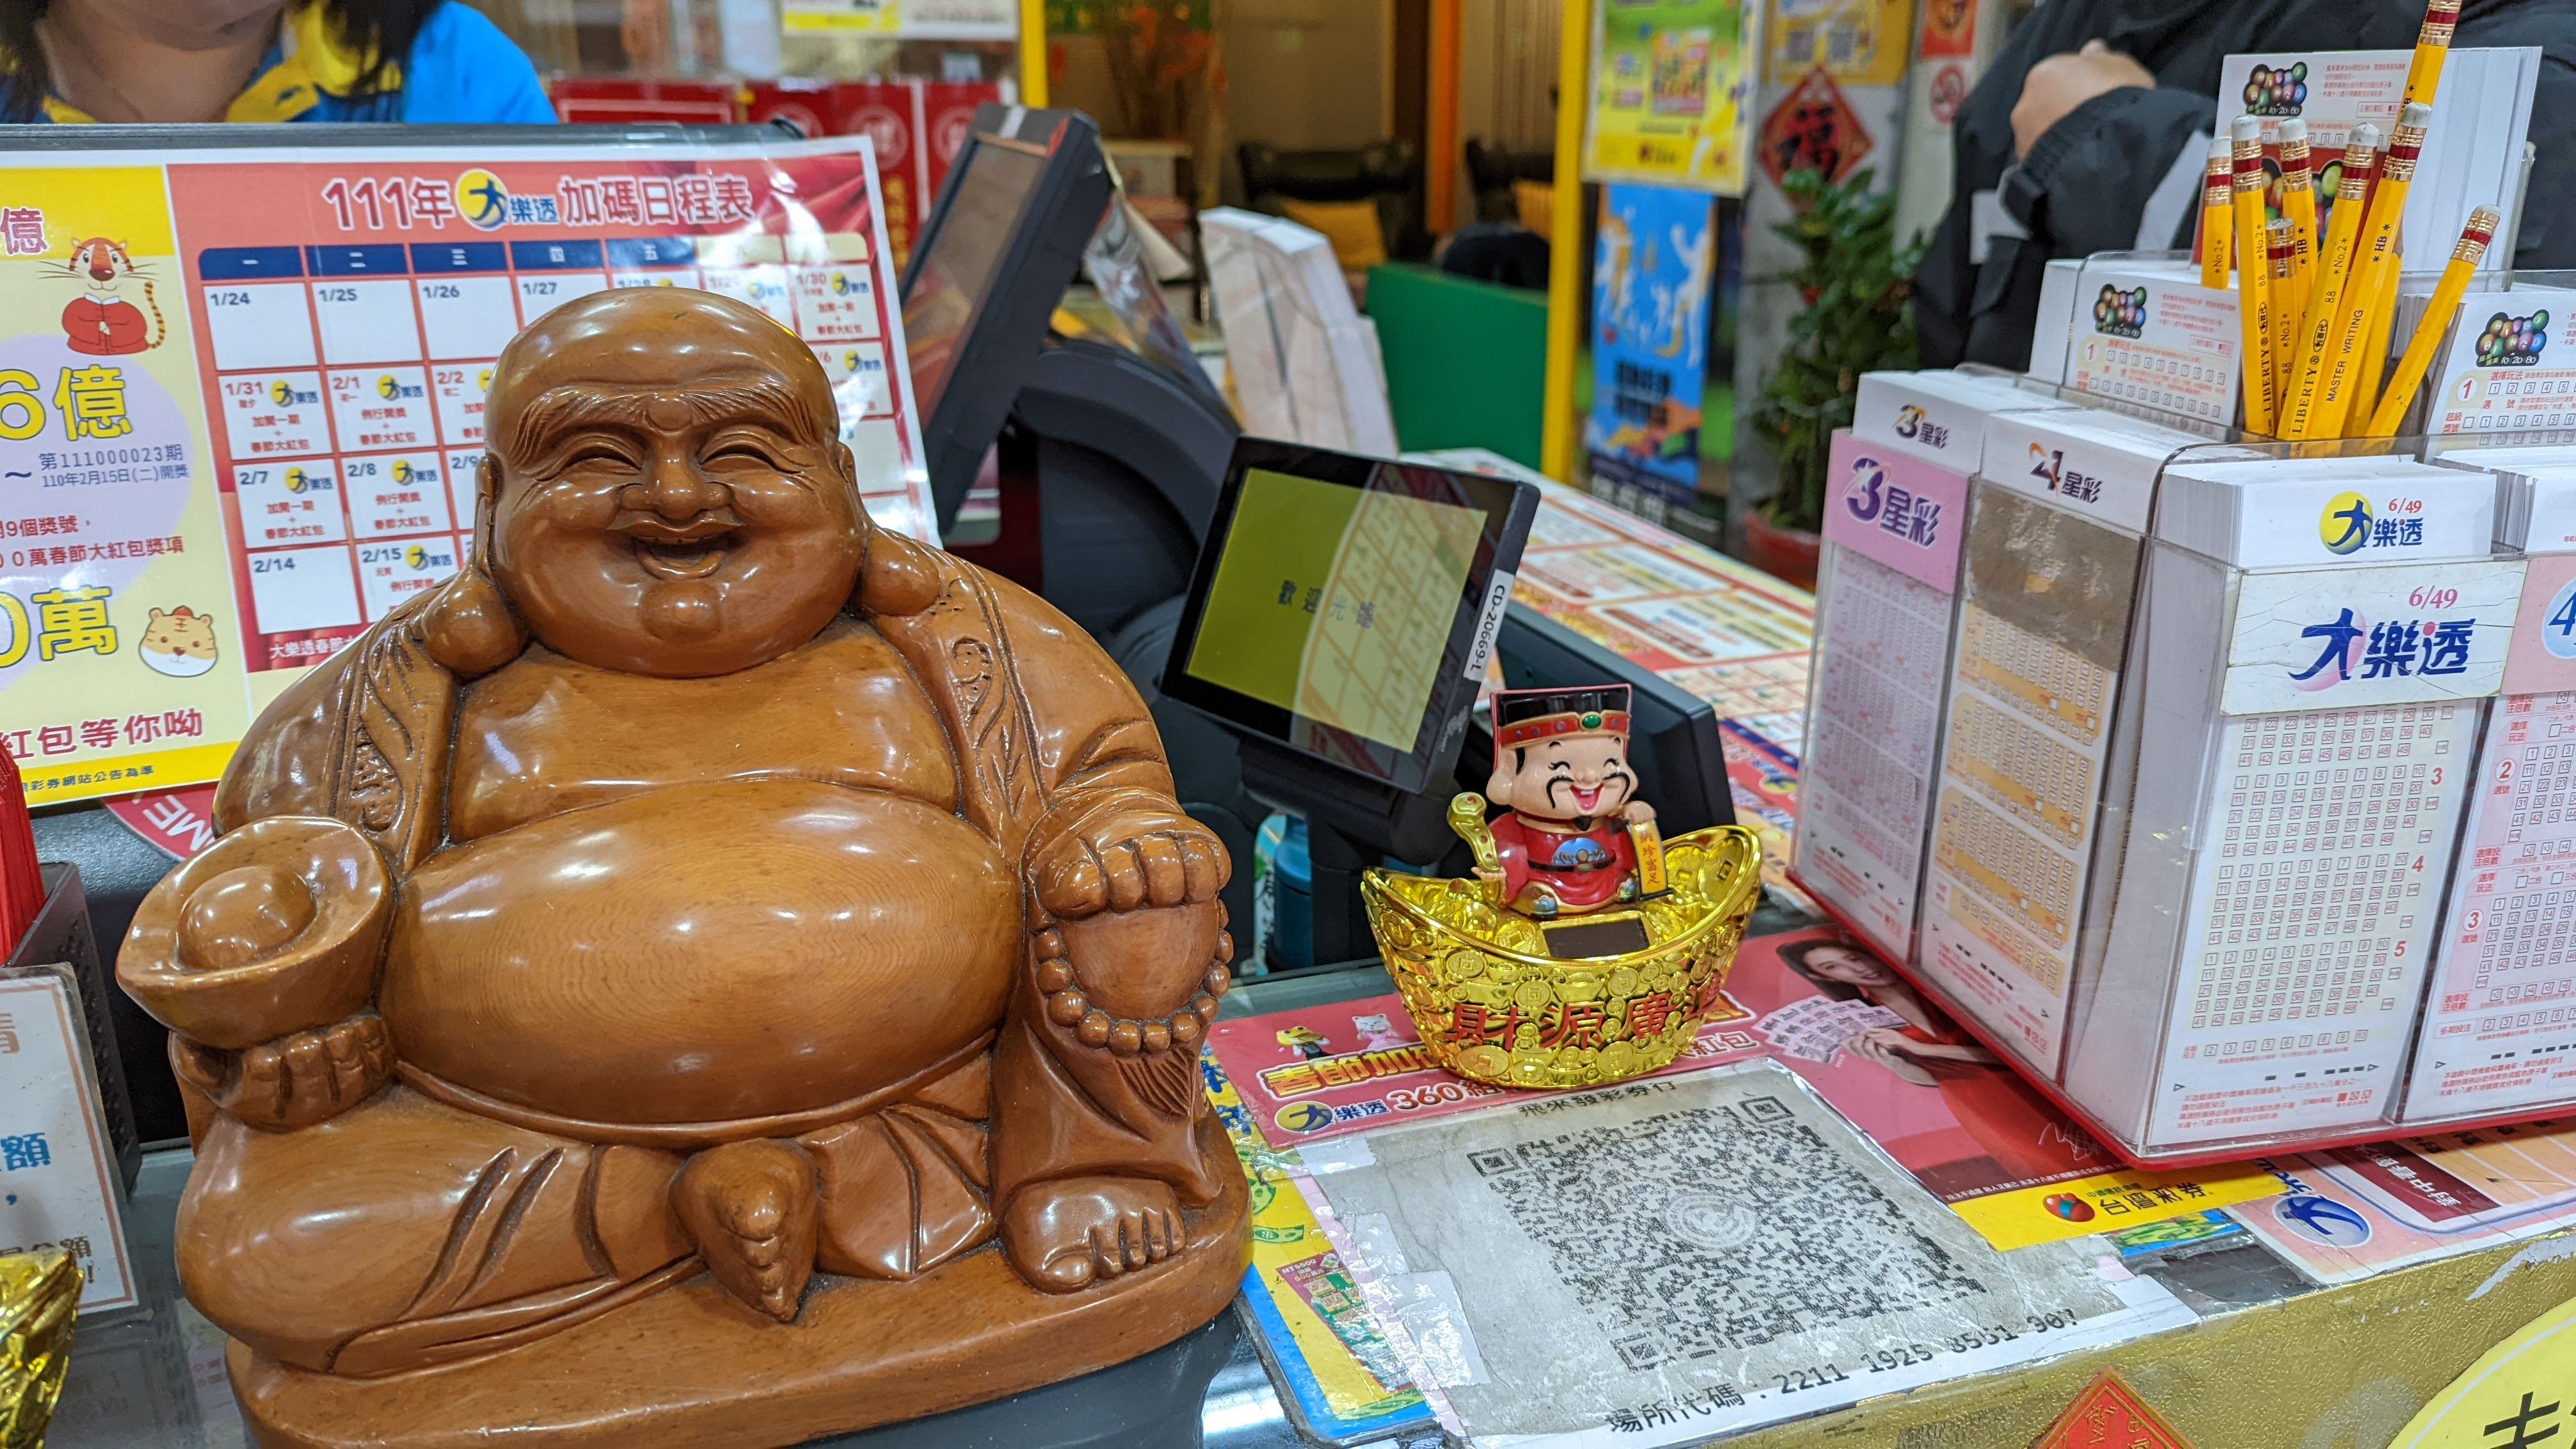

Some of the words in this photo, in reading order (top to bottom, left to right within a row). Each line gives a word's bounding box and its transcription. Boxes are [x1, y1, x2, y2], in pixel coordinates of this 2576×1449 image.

[323, 177, 456, 230] 111年
[561, 175, 755, 226] 加碼日程表
[0, 207, 48, 255] 億
[2297, 238, 2308, 254] HB
[2374, 236, 2388, 252] HB
[349, 251, 366, 268] 二
[452, 248, 468, 266] 三
[318, 287, 358, 303] 1/25
[423, 284, 461, 300] 1/26
[523, 281, 558, 296] 1/27
[210, 292, 251, 307] 1/24
[2326, 360, 2347, 402] MASTER
[2342, 309, 2364, 354] WRITING
[333, 376, 361, 390] 2/1
[437, 371, 464, 384] 2/2
[2261, 349, 2272, 412] LIBERTY
[225, 381, 264, 395] 1/31
[2463, 380, 2472, 399] 1
[2292, 368, 2318, 434] LIBERTY
[1892, 404, 1950, 450] 3星彩
[38, 443, 183, 471] 第111000023期
[240, 471, 268, 485] 2/7
[348, 463, 377, 477] 2/8
[1845, 457, 1942, 548] 3星彩
[2388, 498, 2423, 514] 6/49
[362, 548, 402, 564] 2/15
[254, 557, 296, 573] 2/14
[2409, 585, 2458, 610] 6/49
[1469, 584, 1506, 672] CD-20669-L
[2287, 607, 2476, 682] 大樂透
[2430, 767, 2442, 785] 3
[2498, 761, 2512, 779] 2
[143, 795, 216, 852] ME
[2412, 855, 2424, 872] 4
[2468, 912, 2480, 928] 3
[2394, 940, 2406, 957] 5
[2099, 1182, 2207, 1215] 台灣彩券
[1771, 1363, 1850, 1394] 2211
